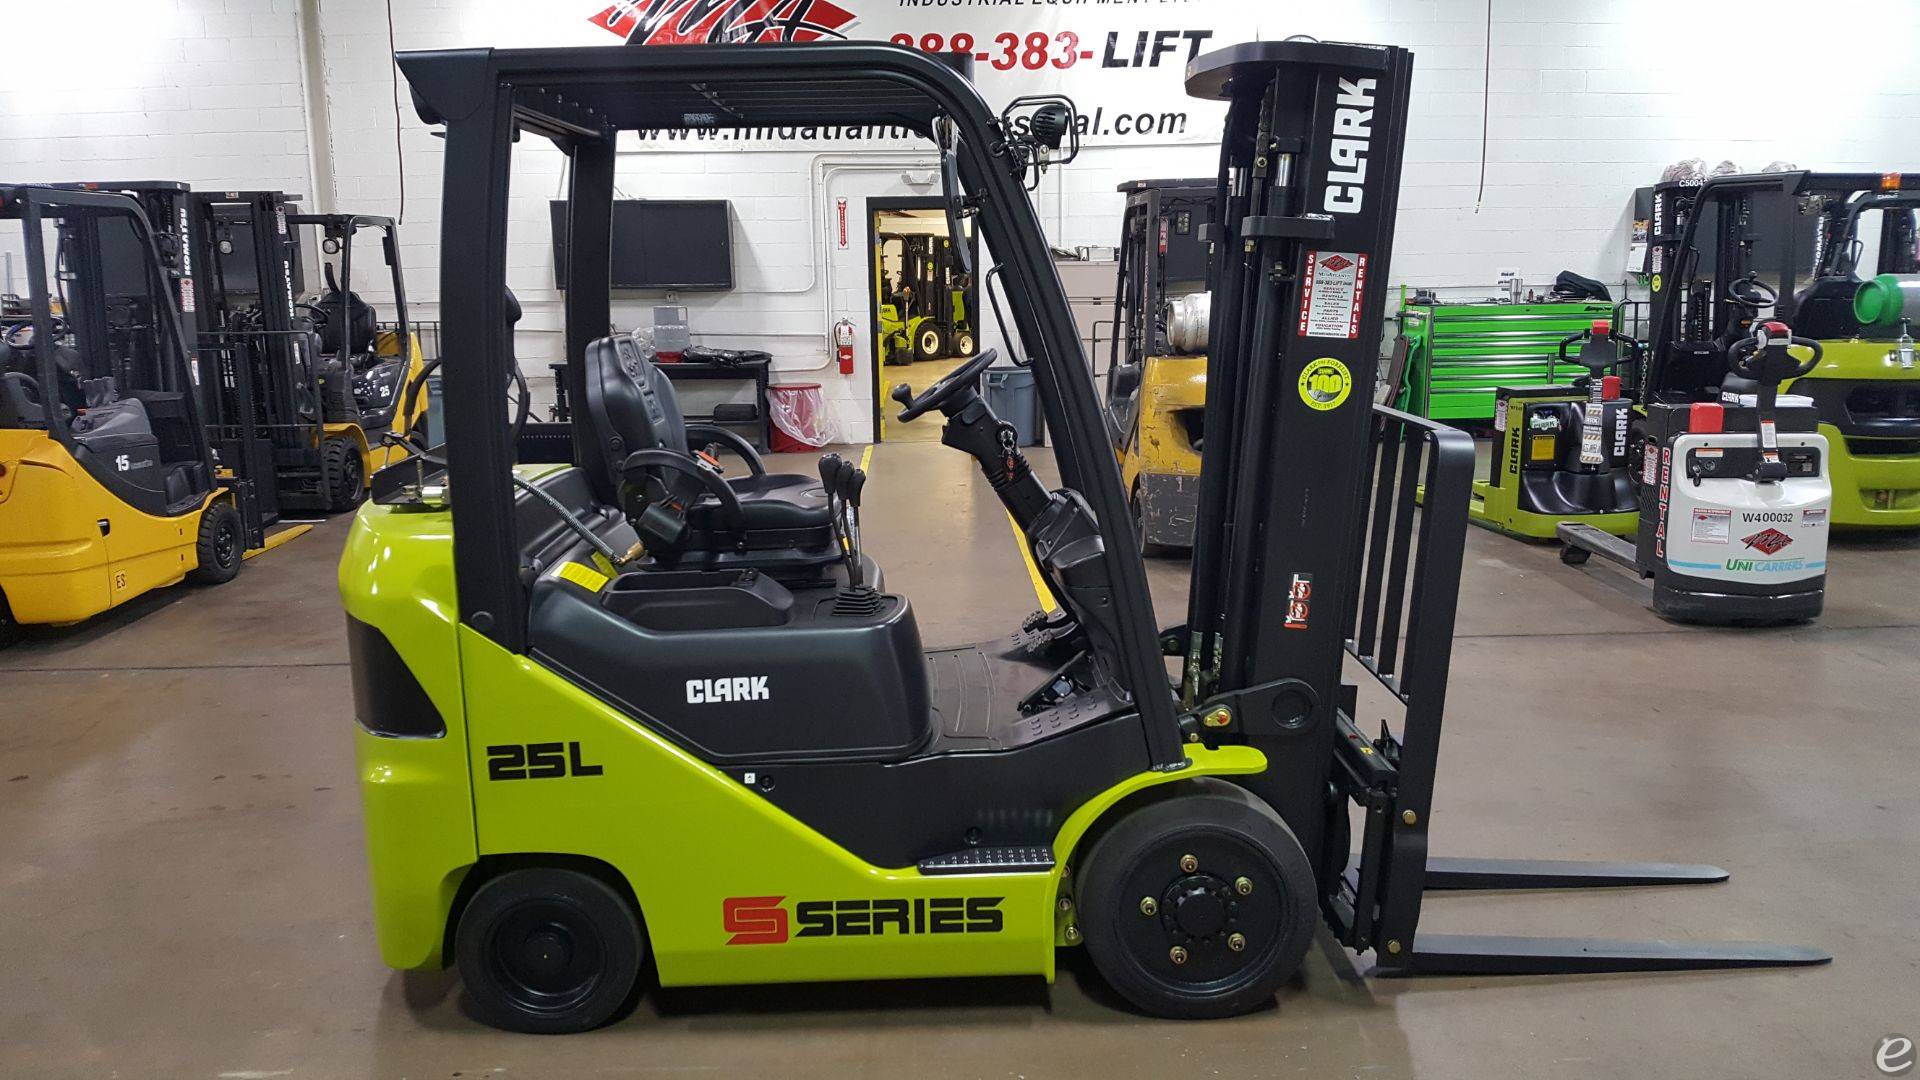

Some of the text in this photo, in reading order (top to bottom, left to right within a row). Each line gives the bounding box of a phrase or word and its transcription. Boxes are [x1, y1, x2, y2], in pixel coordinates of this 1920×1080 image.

[1323, 76, 1377, 214] CLARK
[1653, 193, 1663, 236] CLARK
[180, 207, 192, 276] KOMATSU
[1300, 254, 1314, 332] SERVICE
[1350, 257, 1366, 334] RENTALS
[379, 385, 390, 397] 25
[1509, 427, 1521, 475] CLARK
[1613, 408, 1628, 457] CLARK
[115, 454, 130, 471] 15
[1655, 447, 1671, 558] RENTAL
[1742, 512, 1794, 523] W400032
[685, 675, 770, 704] CLARK
[486, 741, 604, 781] 25L
[723, 896, 1006, 945] S SERIES
